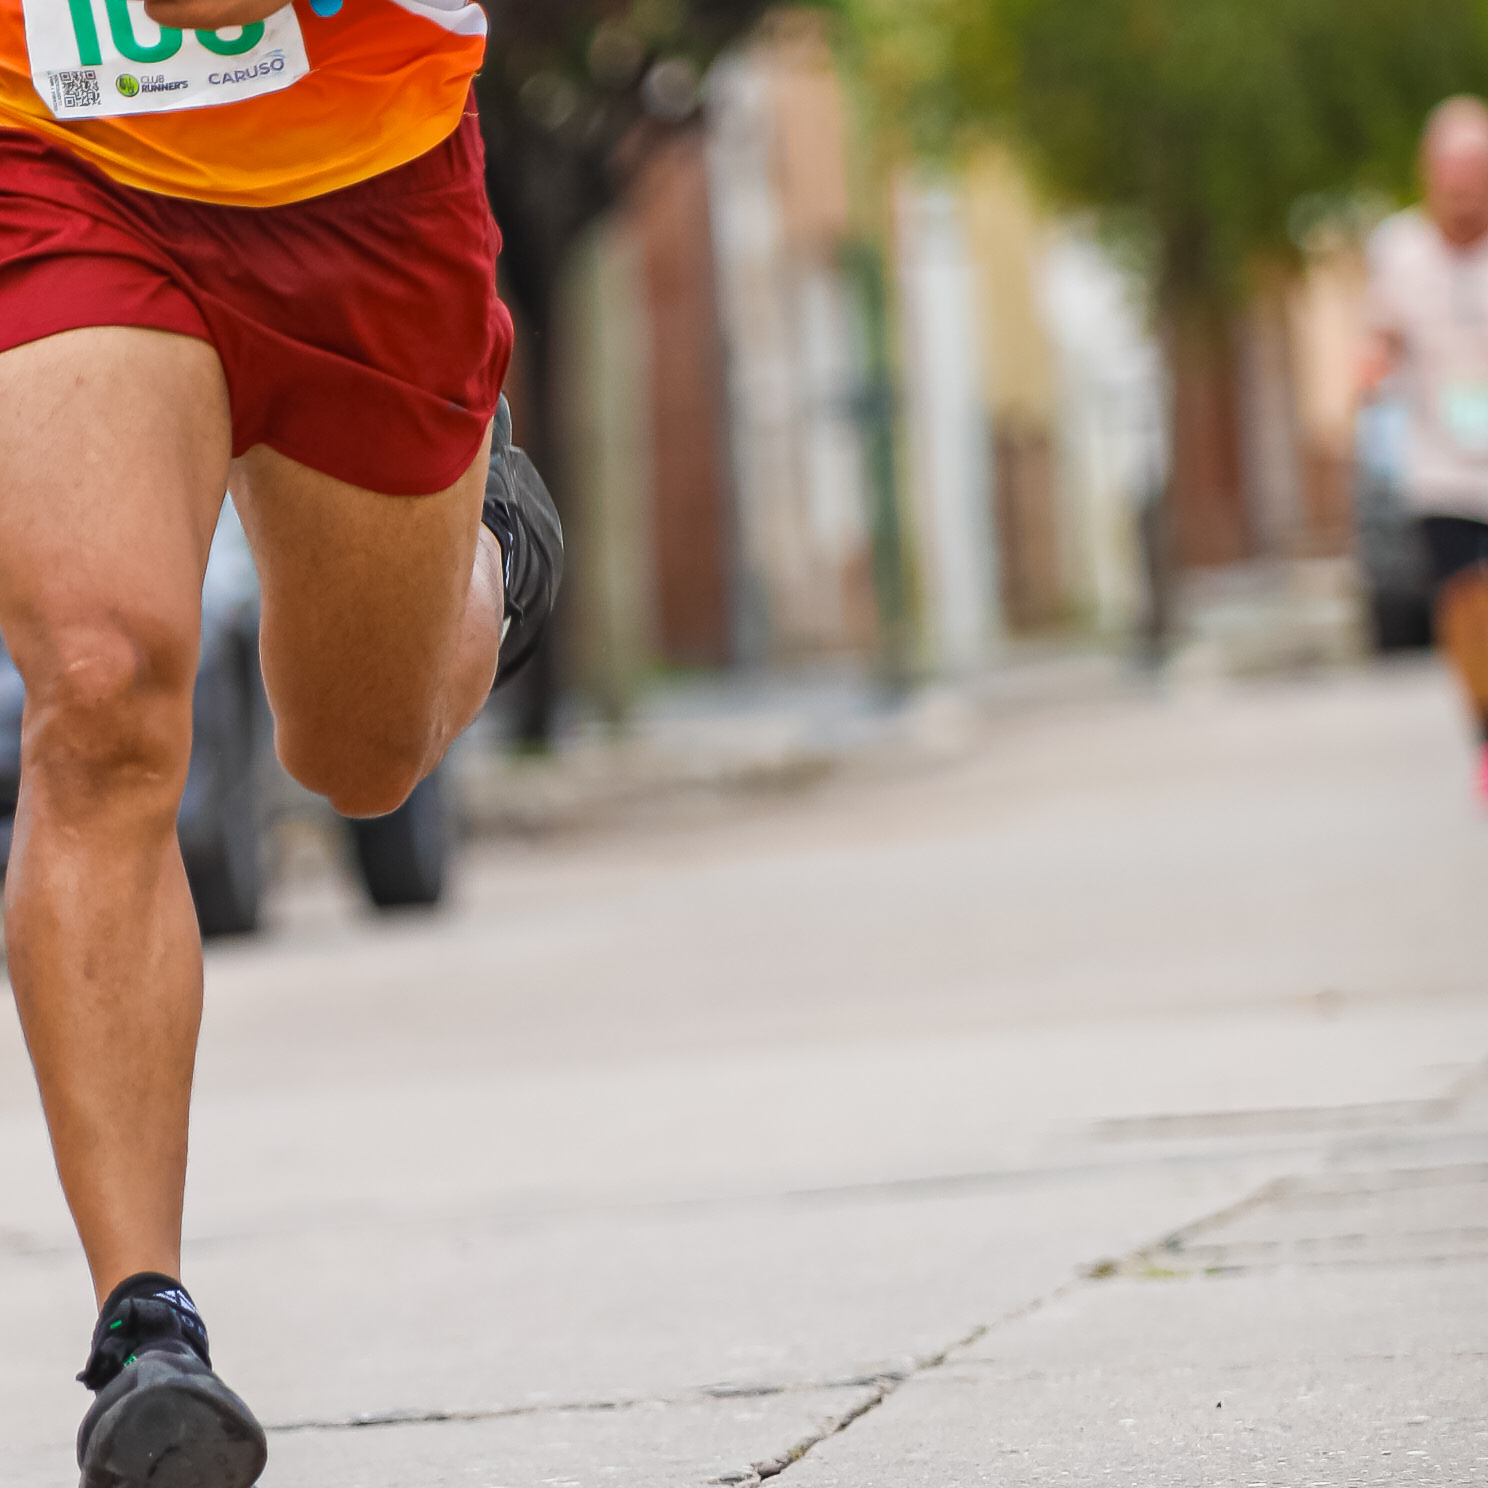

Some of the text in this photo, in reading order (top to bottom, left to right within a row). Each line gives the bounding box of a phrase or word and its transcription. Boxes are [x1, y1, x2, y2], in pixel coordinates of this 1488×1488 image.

[208, 57, 284, 85] CARUSO
[140, 74, 165, 84] CLUB
[141, 80, 189, 93] RUNNER'S
